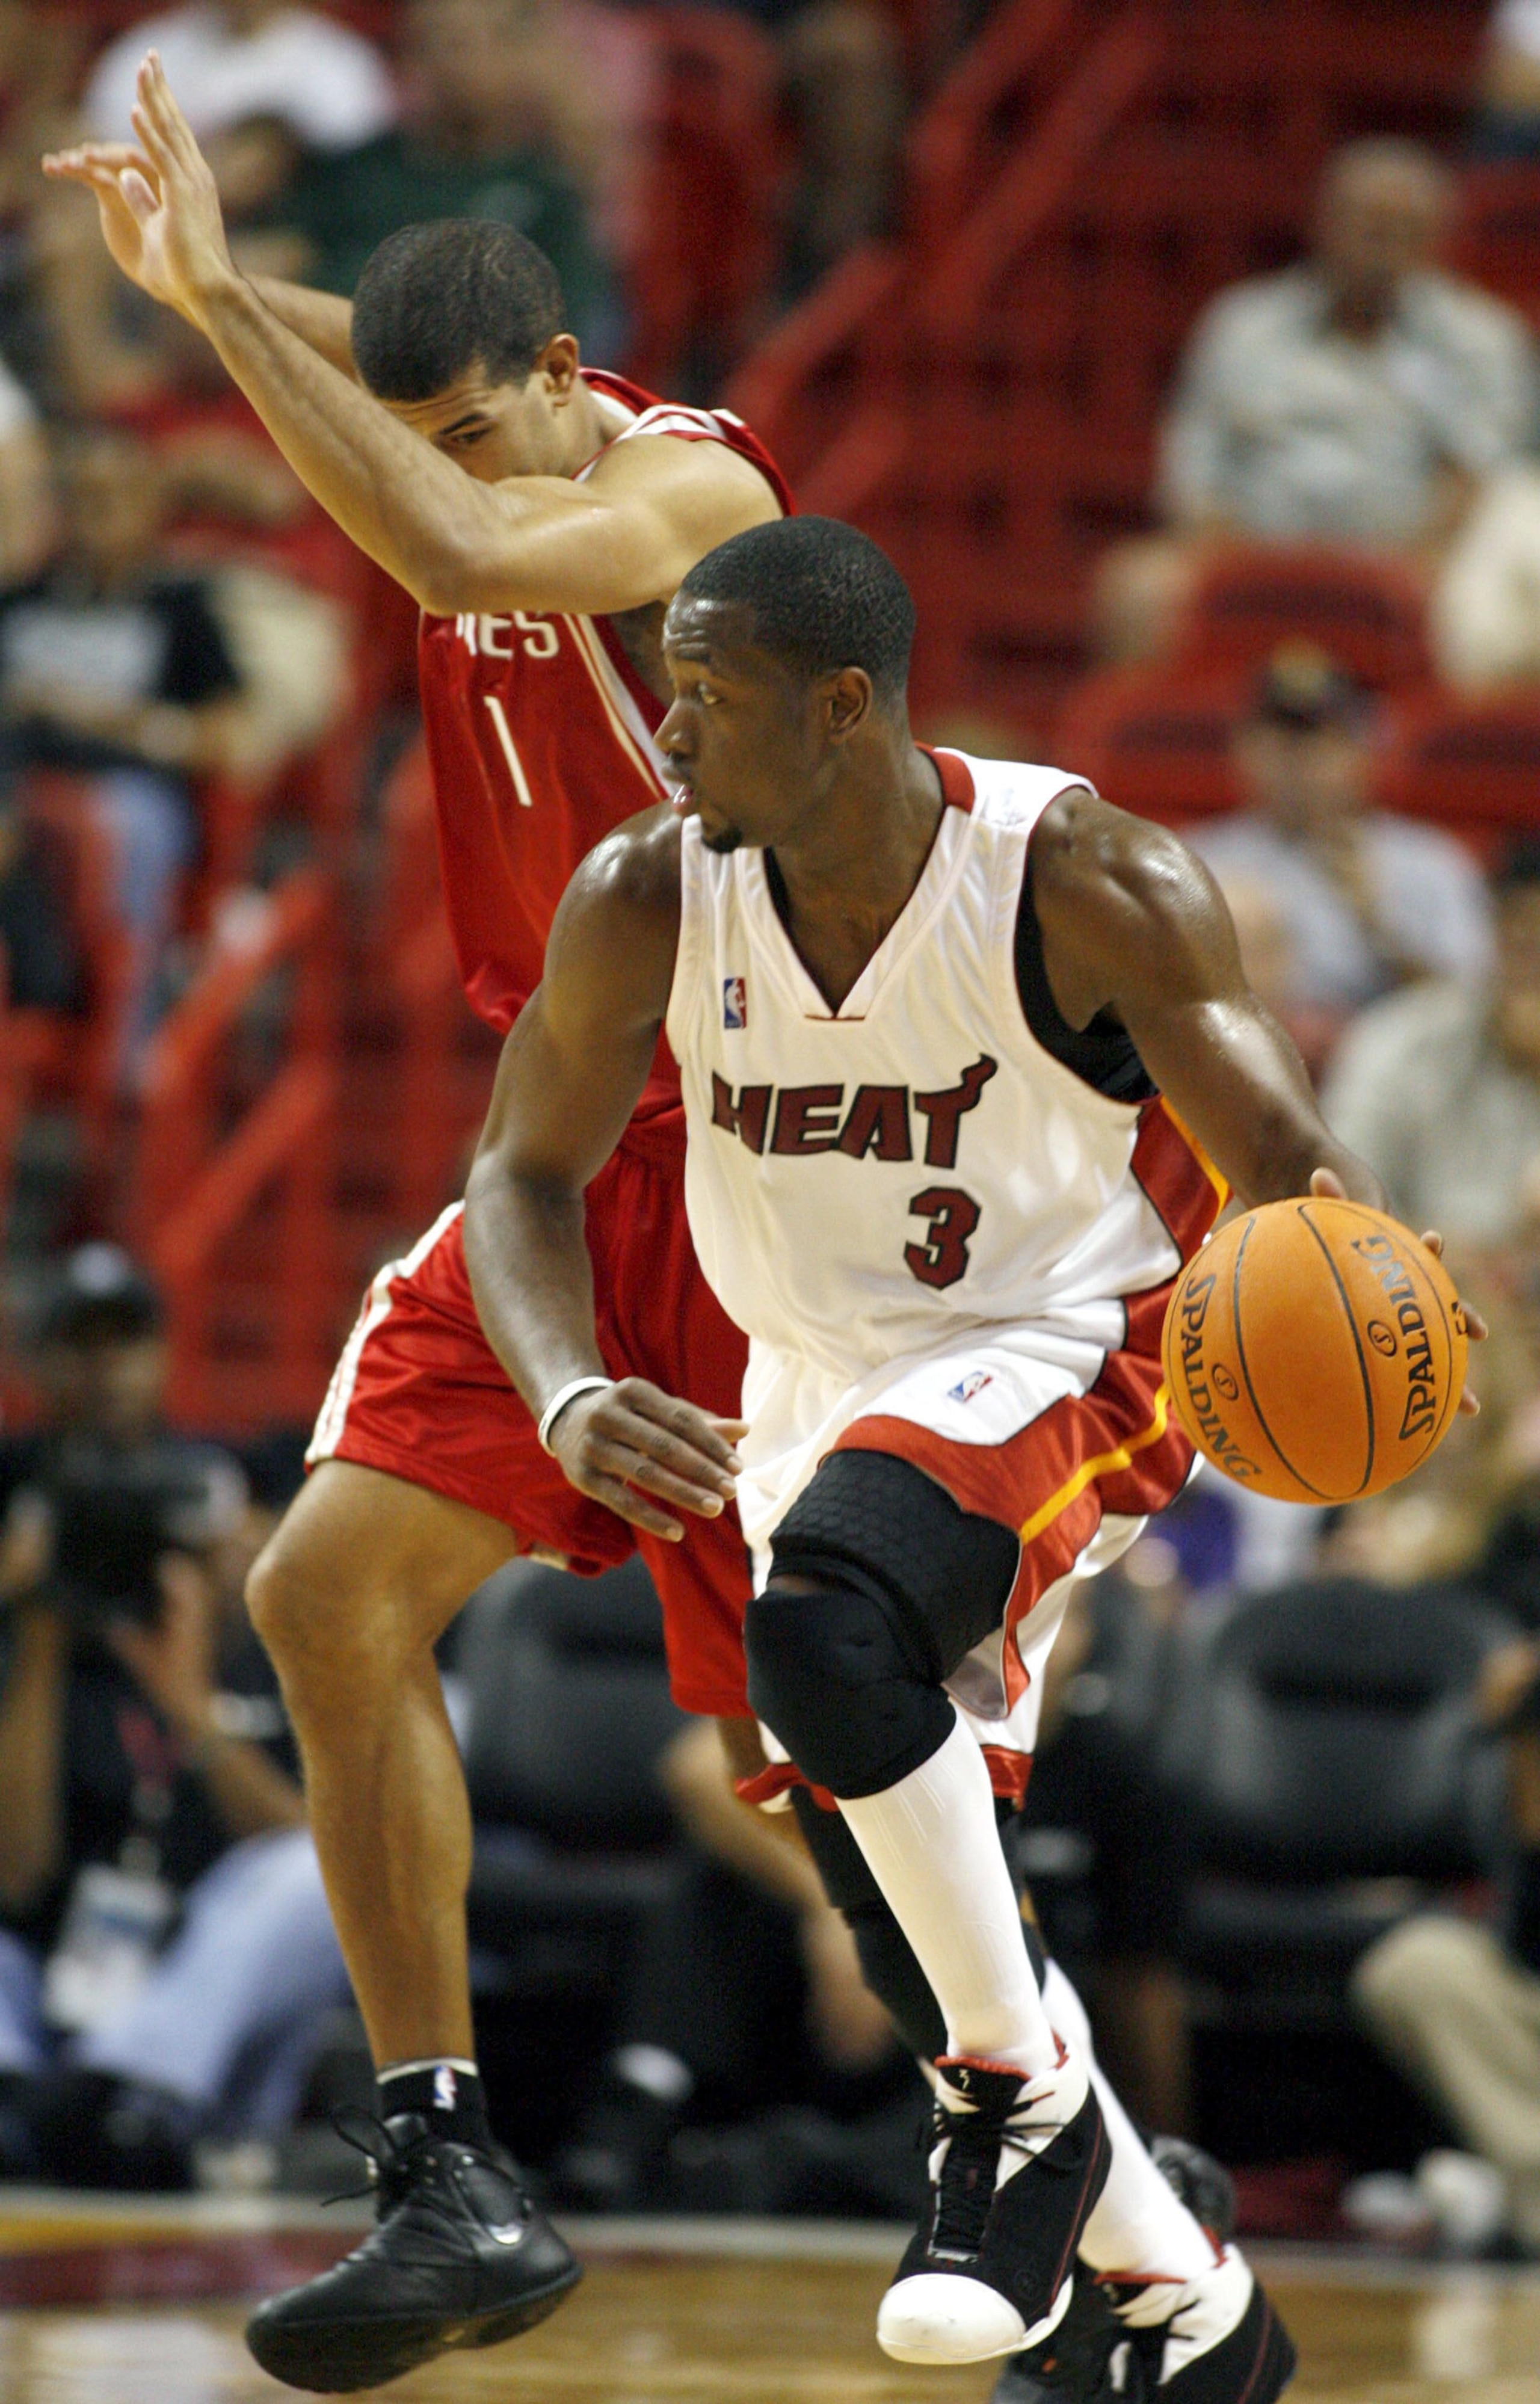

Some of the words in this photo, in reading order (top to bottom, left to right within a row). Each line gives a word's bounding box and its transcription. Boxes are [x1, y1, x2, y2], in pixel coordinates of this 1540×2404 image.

[484, 695, 532, 806] 1
[711, 1052, 999, 1170] HEAT
[904, 1186, 982, 1290] 3
[1181, 1274, 1262, 1477] SPALDING
[1351, 1236, 1436, 1440] SPALDING
